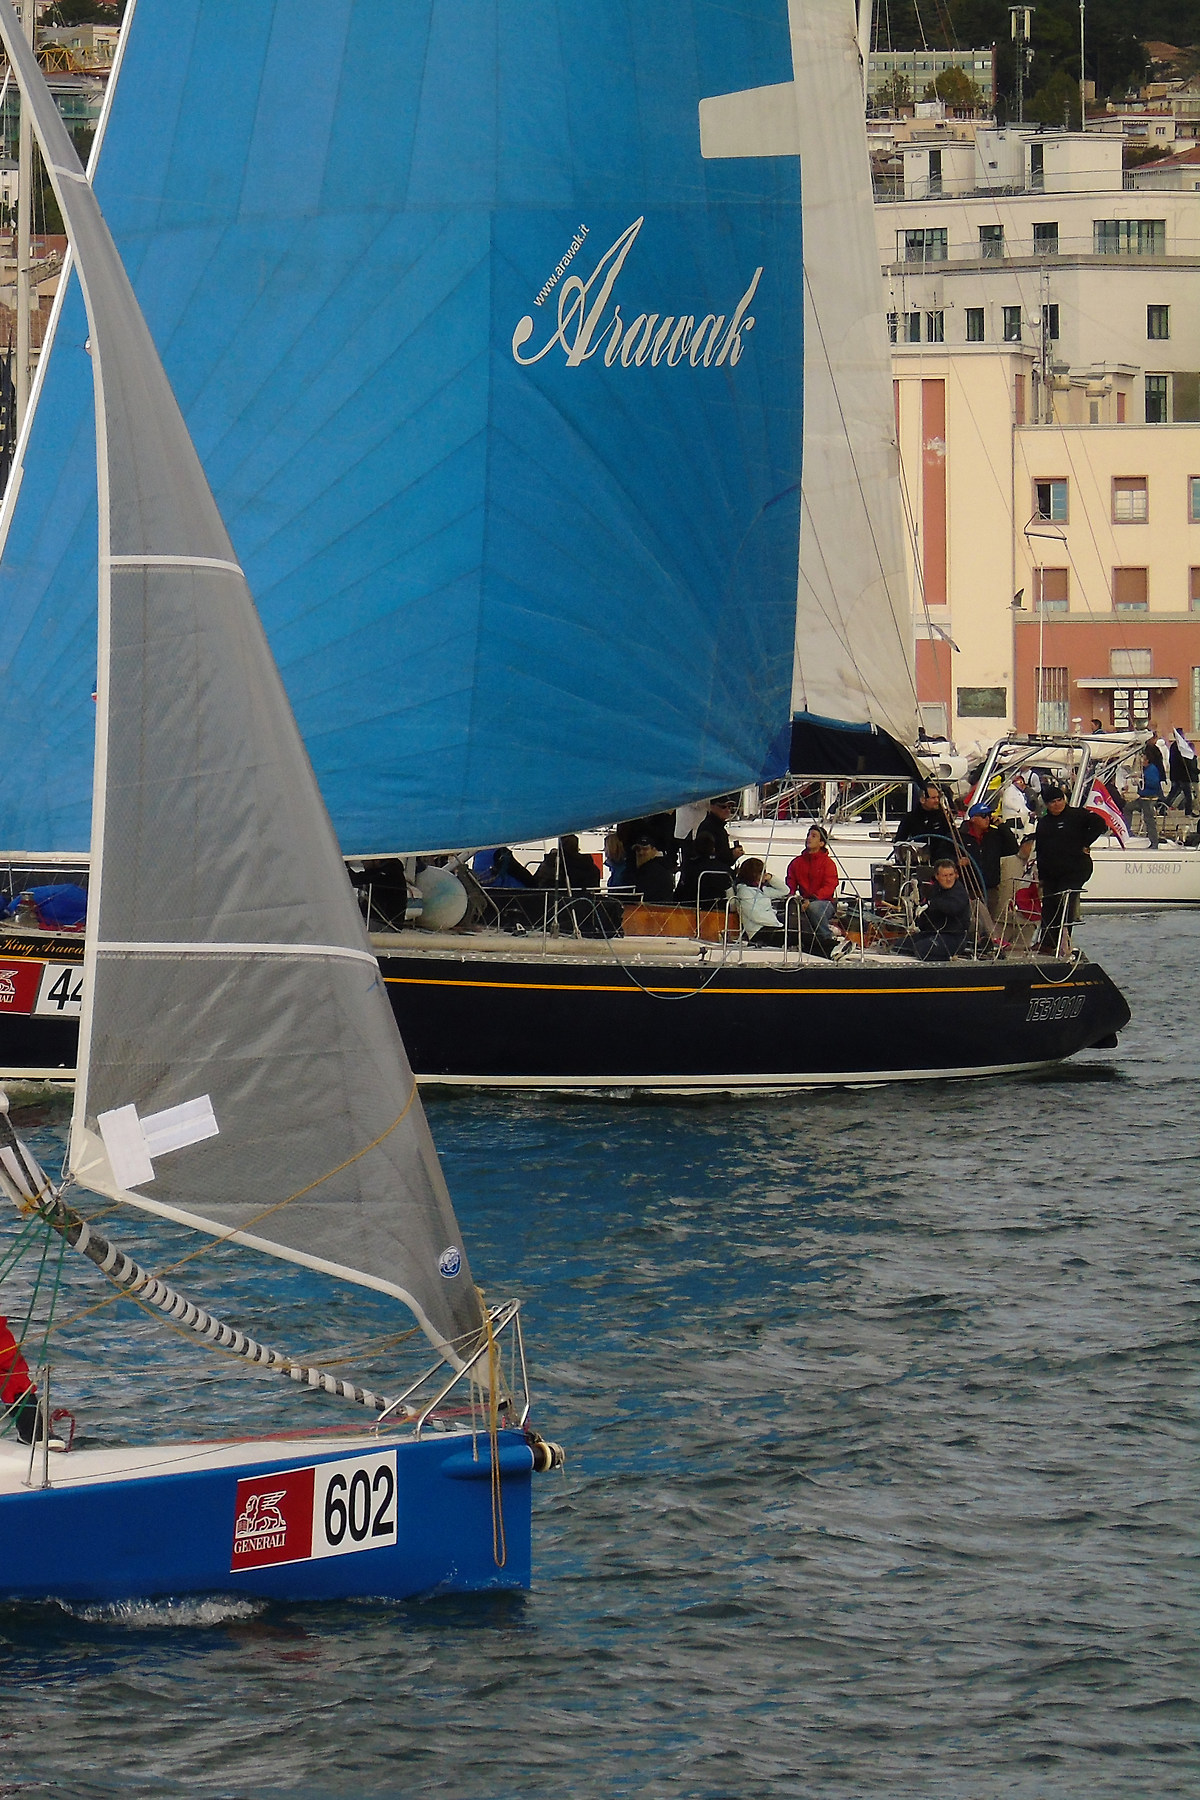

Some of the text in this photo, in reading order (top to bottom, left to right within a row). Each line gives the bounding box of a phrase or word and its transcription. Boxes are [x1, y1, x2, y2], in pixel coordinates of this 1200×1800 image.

[533, 223, 590, 306] www.arawak.it
[512, 215, 764, 367] Arawak
[1124, 862, 1182, 875] RM 3888 D
[0, 938, 85, 957] King Arawa
[324, 1464, 395, 1547] 602
[234, 1533, 286, 1554] GENERALI
